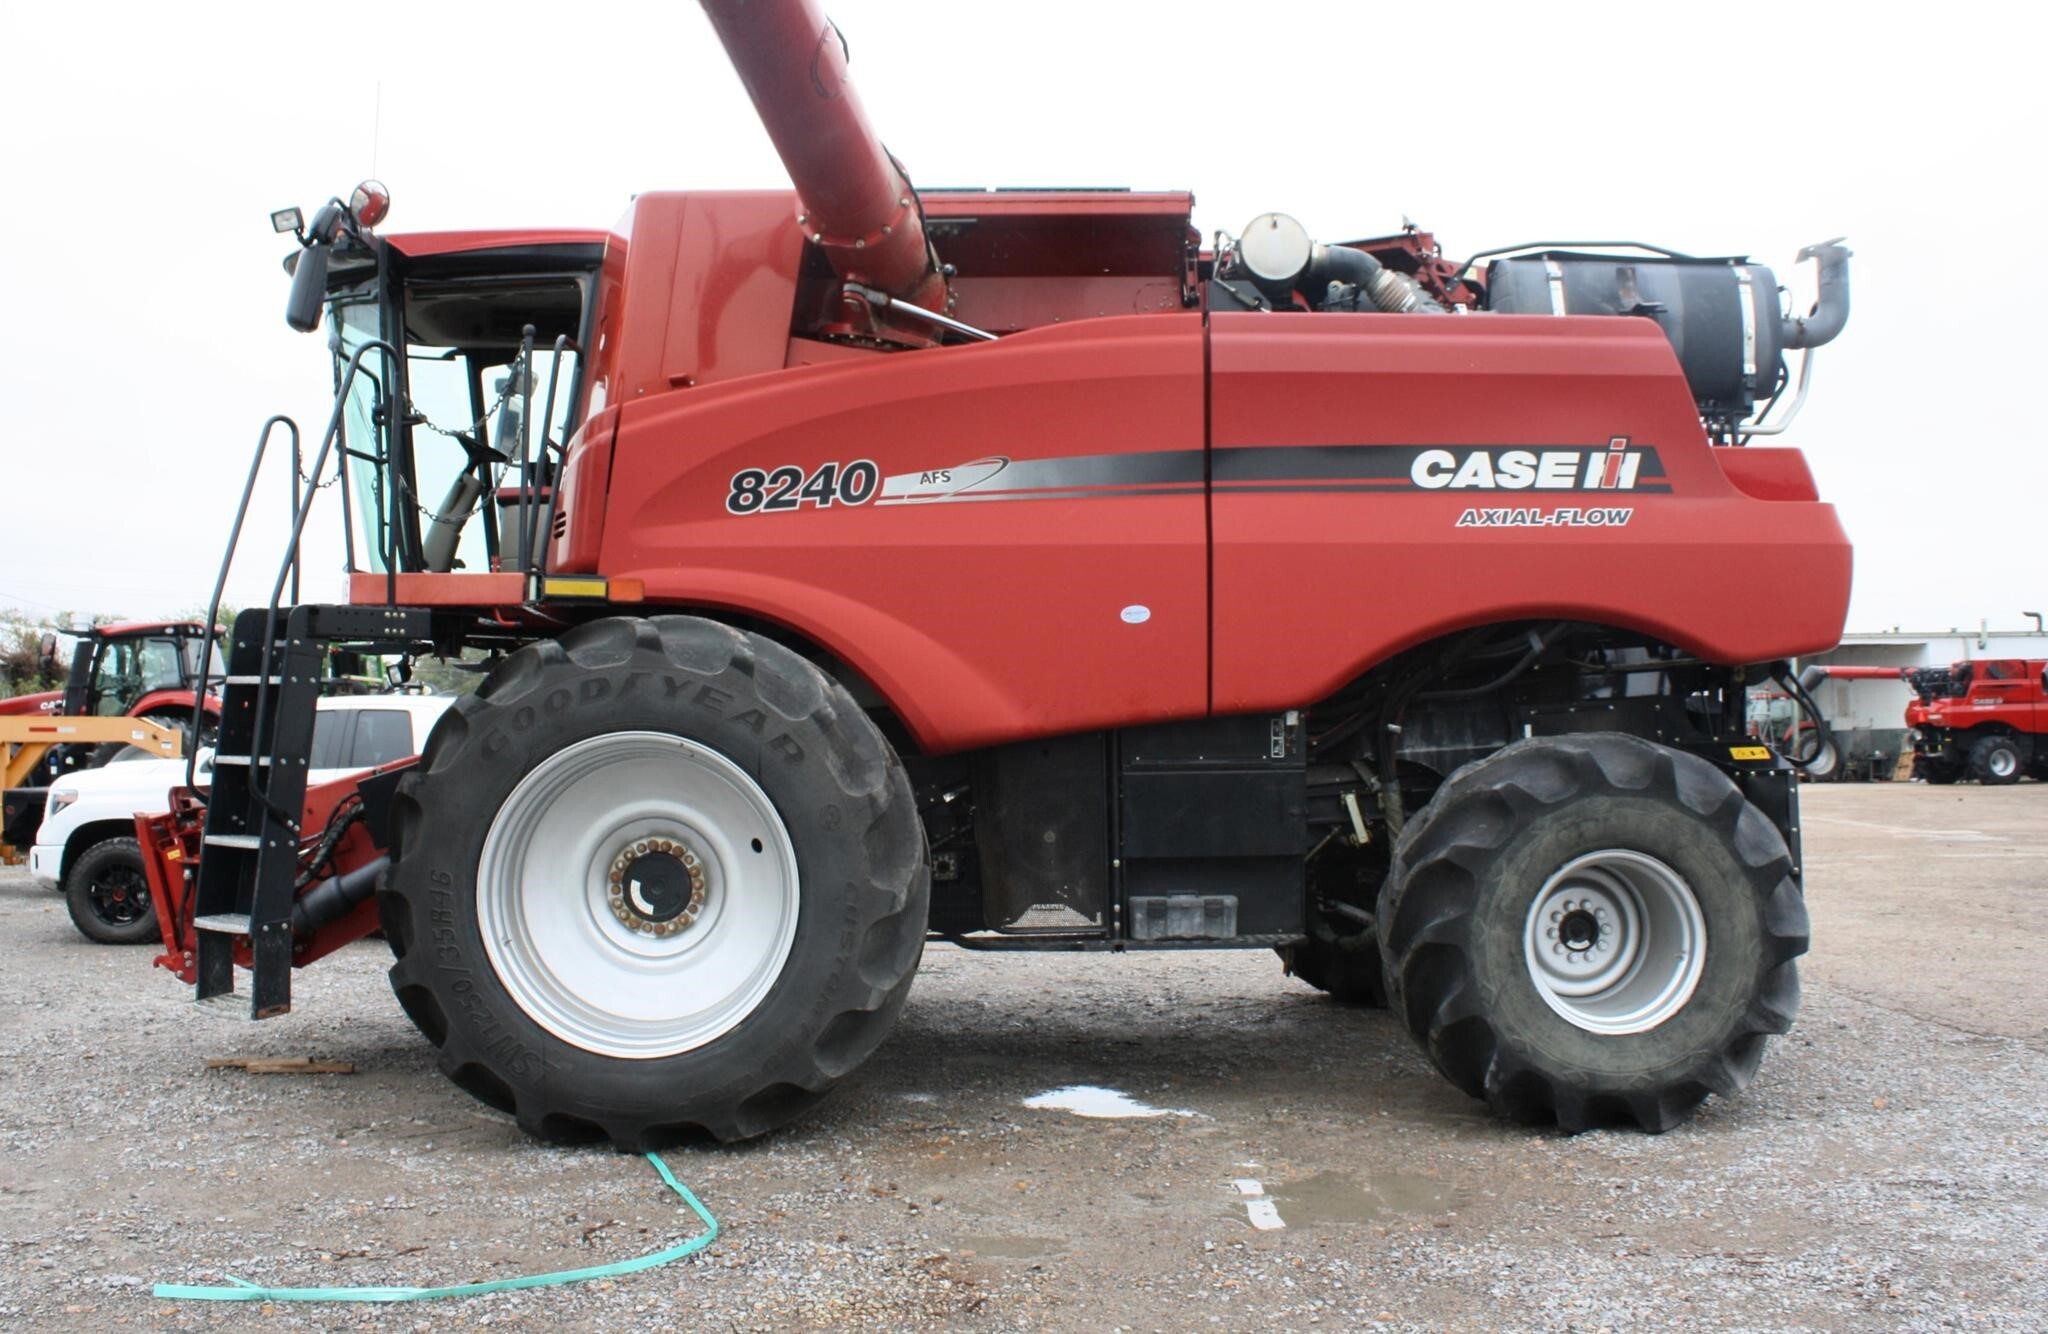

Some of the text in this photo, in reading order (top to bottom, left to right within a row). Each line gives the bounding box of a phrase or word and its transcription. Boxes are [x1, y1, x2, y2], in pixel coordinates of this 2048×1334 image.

[920, 470, 951, 485] AFS
[1411, 449, 1580, 489] CASE
[727, 459, 878, 515] 8240
[1456, 508, 1634, 527] AXIAL-FLOW
